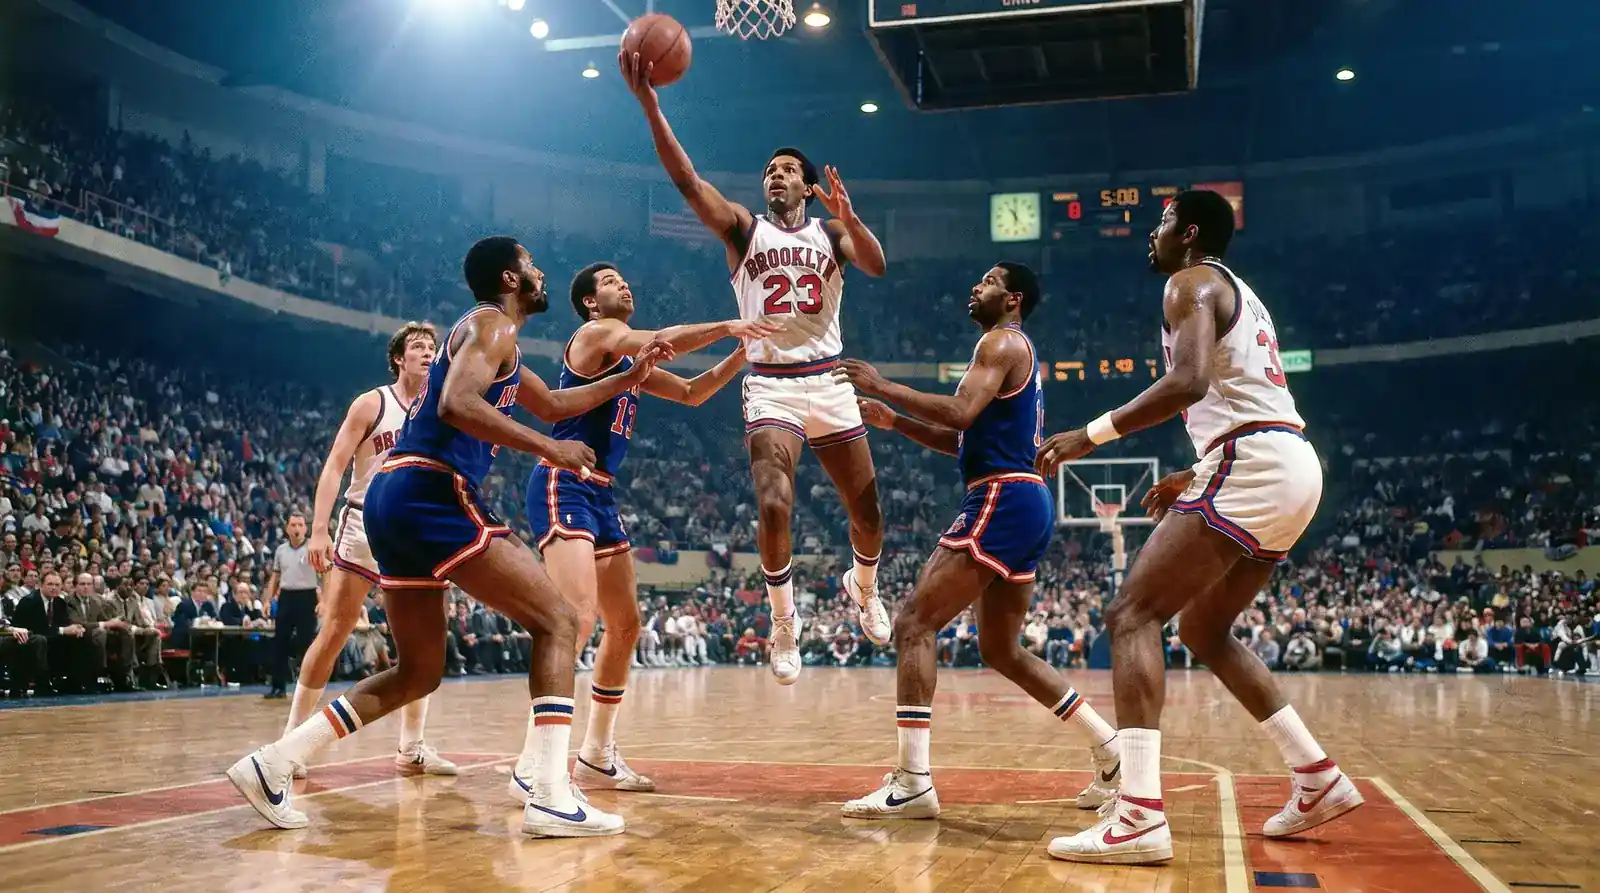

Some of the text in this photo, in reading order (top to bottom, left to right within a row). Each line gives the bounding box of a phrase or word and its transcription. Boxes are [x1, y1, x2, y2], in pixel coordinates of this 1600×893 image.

[1100, 188, 1139, 206] 5:00
[763, 274, 823, 316] 23
[610, 397, 637, 440] 13
